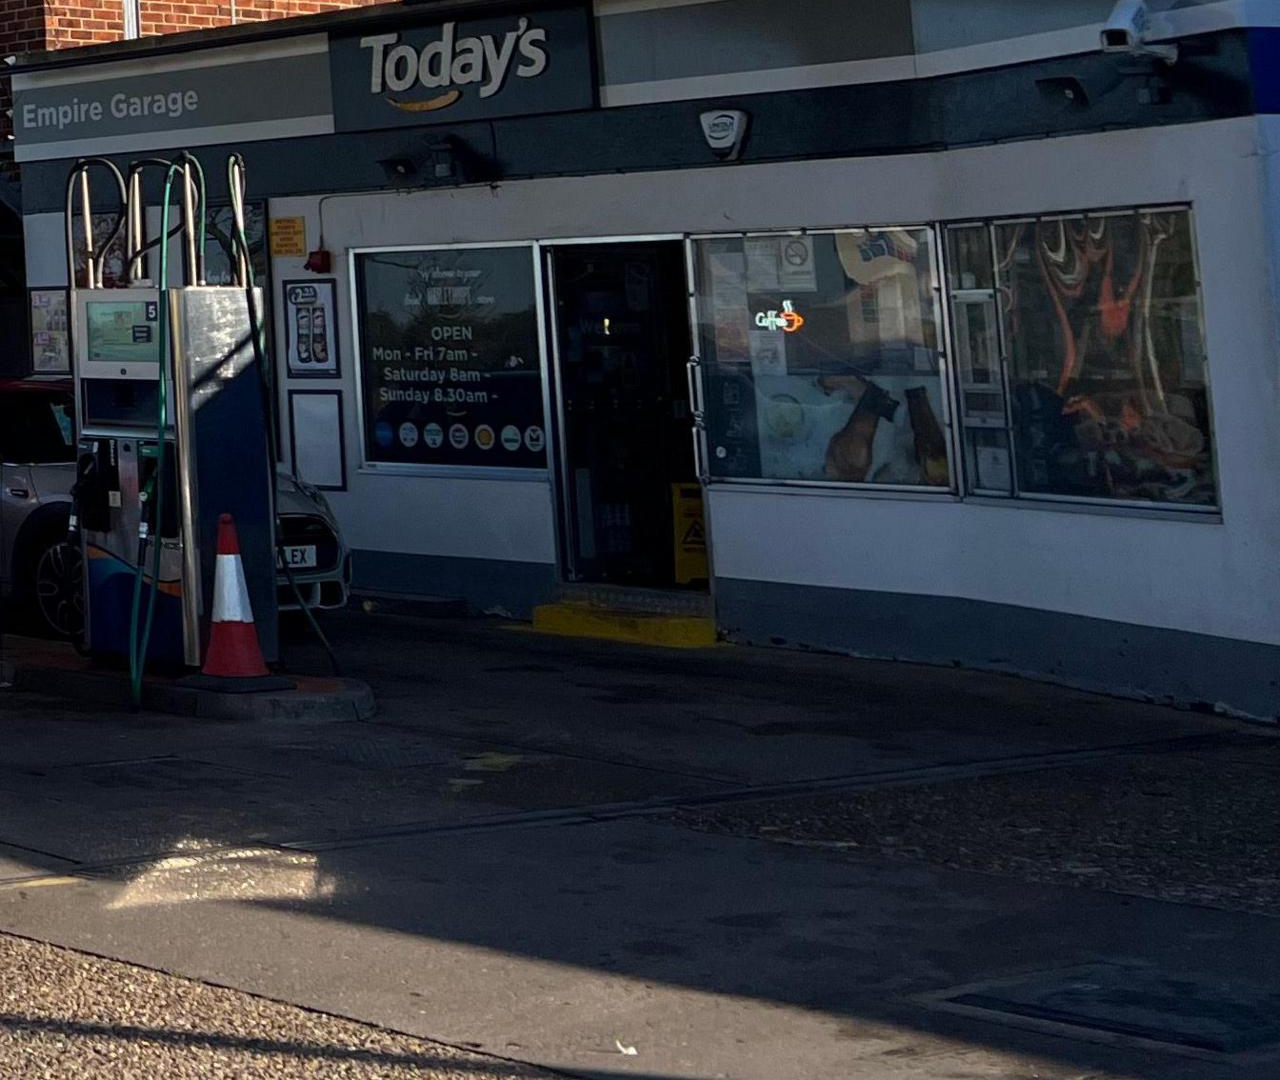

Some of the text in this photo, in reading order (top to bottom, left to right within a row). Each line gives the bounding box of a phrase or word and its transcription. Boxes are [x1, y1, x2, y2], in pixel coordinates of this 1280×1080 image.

[360, 17, 546, 98] Today's
[23, 90, 198, 130] Empire Garage
[148, 305, 156, 318] 5
[431, 326, 472, 340] OPEN
[373, 347, 401, 361] Mon
[414, 347, 433, 361] Fri
[438, 347, 468, 361] 7am
[384, 367, 447, 383] Saturday
[450, 368, 480, 382] 8am
[380, 388, 430, 404] Sunday
[434, 389, 488, 403] 8.30am
